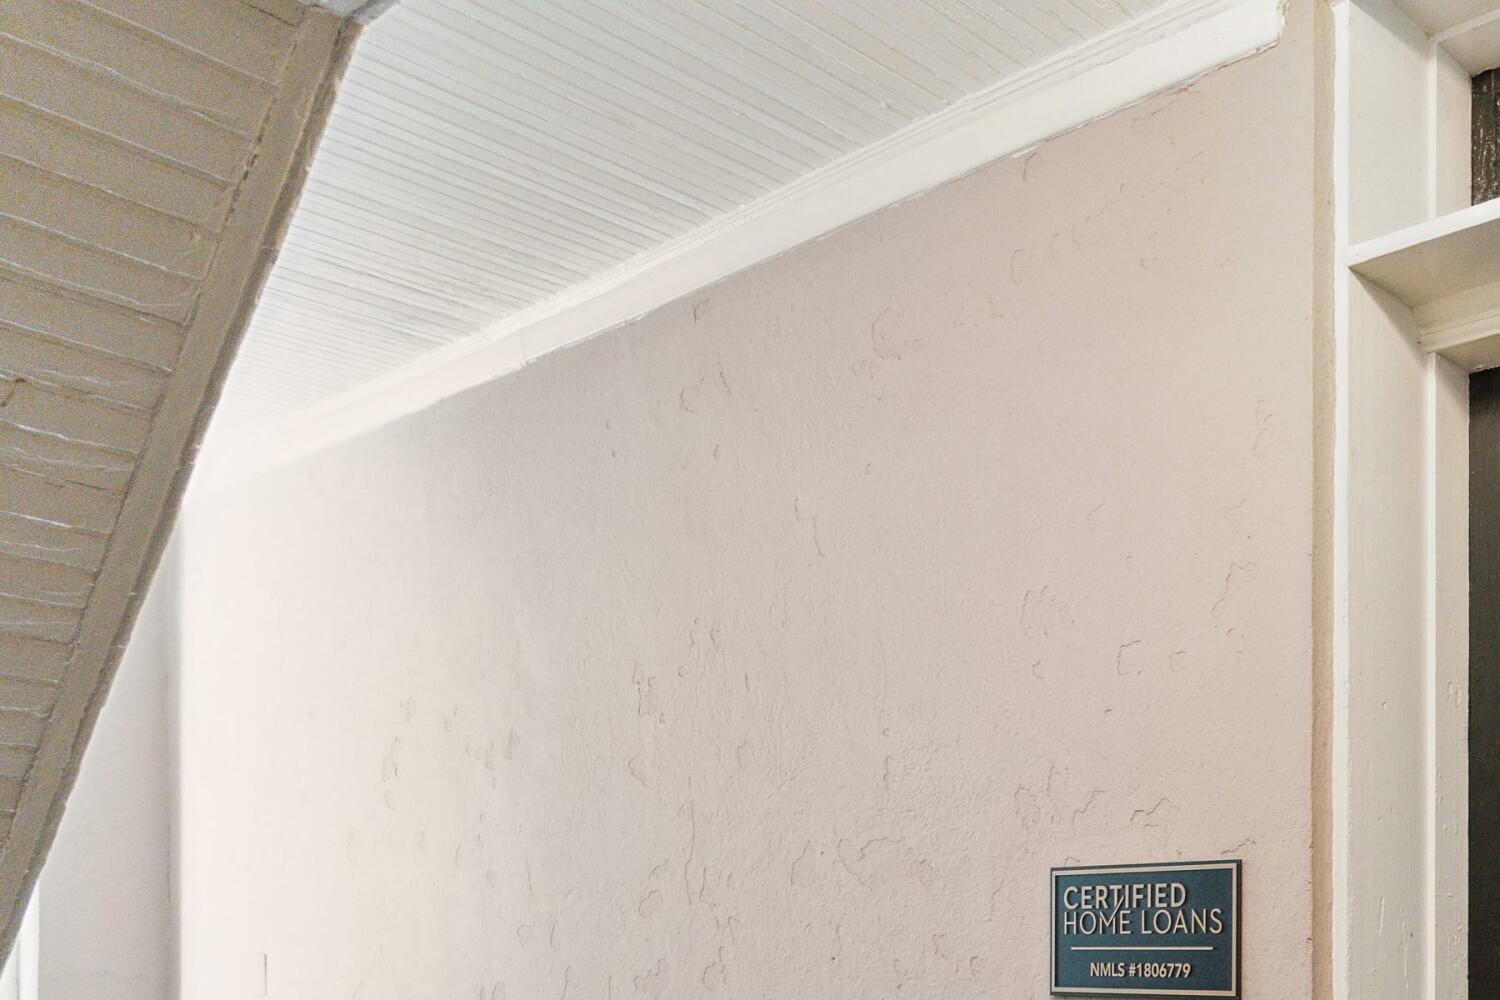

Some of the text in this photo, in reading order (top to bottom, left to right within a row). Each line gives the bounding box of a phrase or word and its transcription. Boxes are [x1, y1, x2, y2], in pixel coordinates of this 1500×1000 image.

[1063, 882, 1187, 910] CERTIFIED
[1063, 908, 1223, 935] HOME LOANS
[1089, 962, 1191, 979] NMLS #1806779
